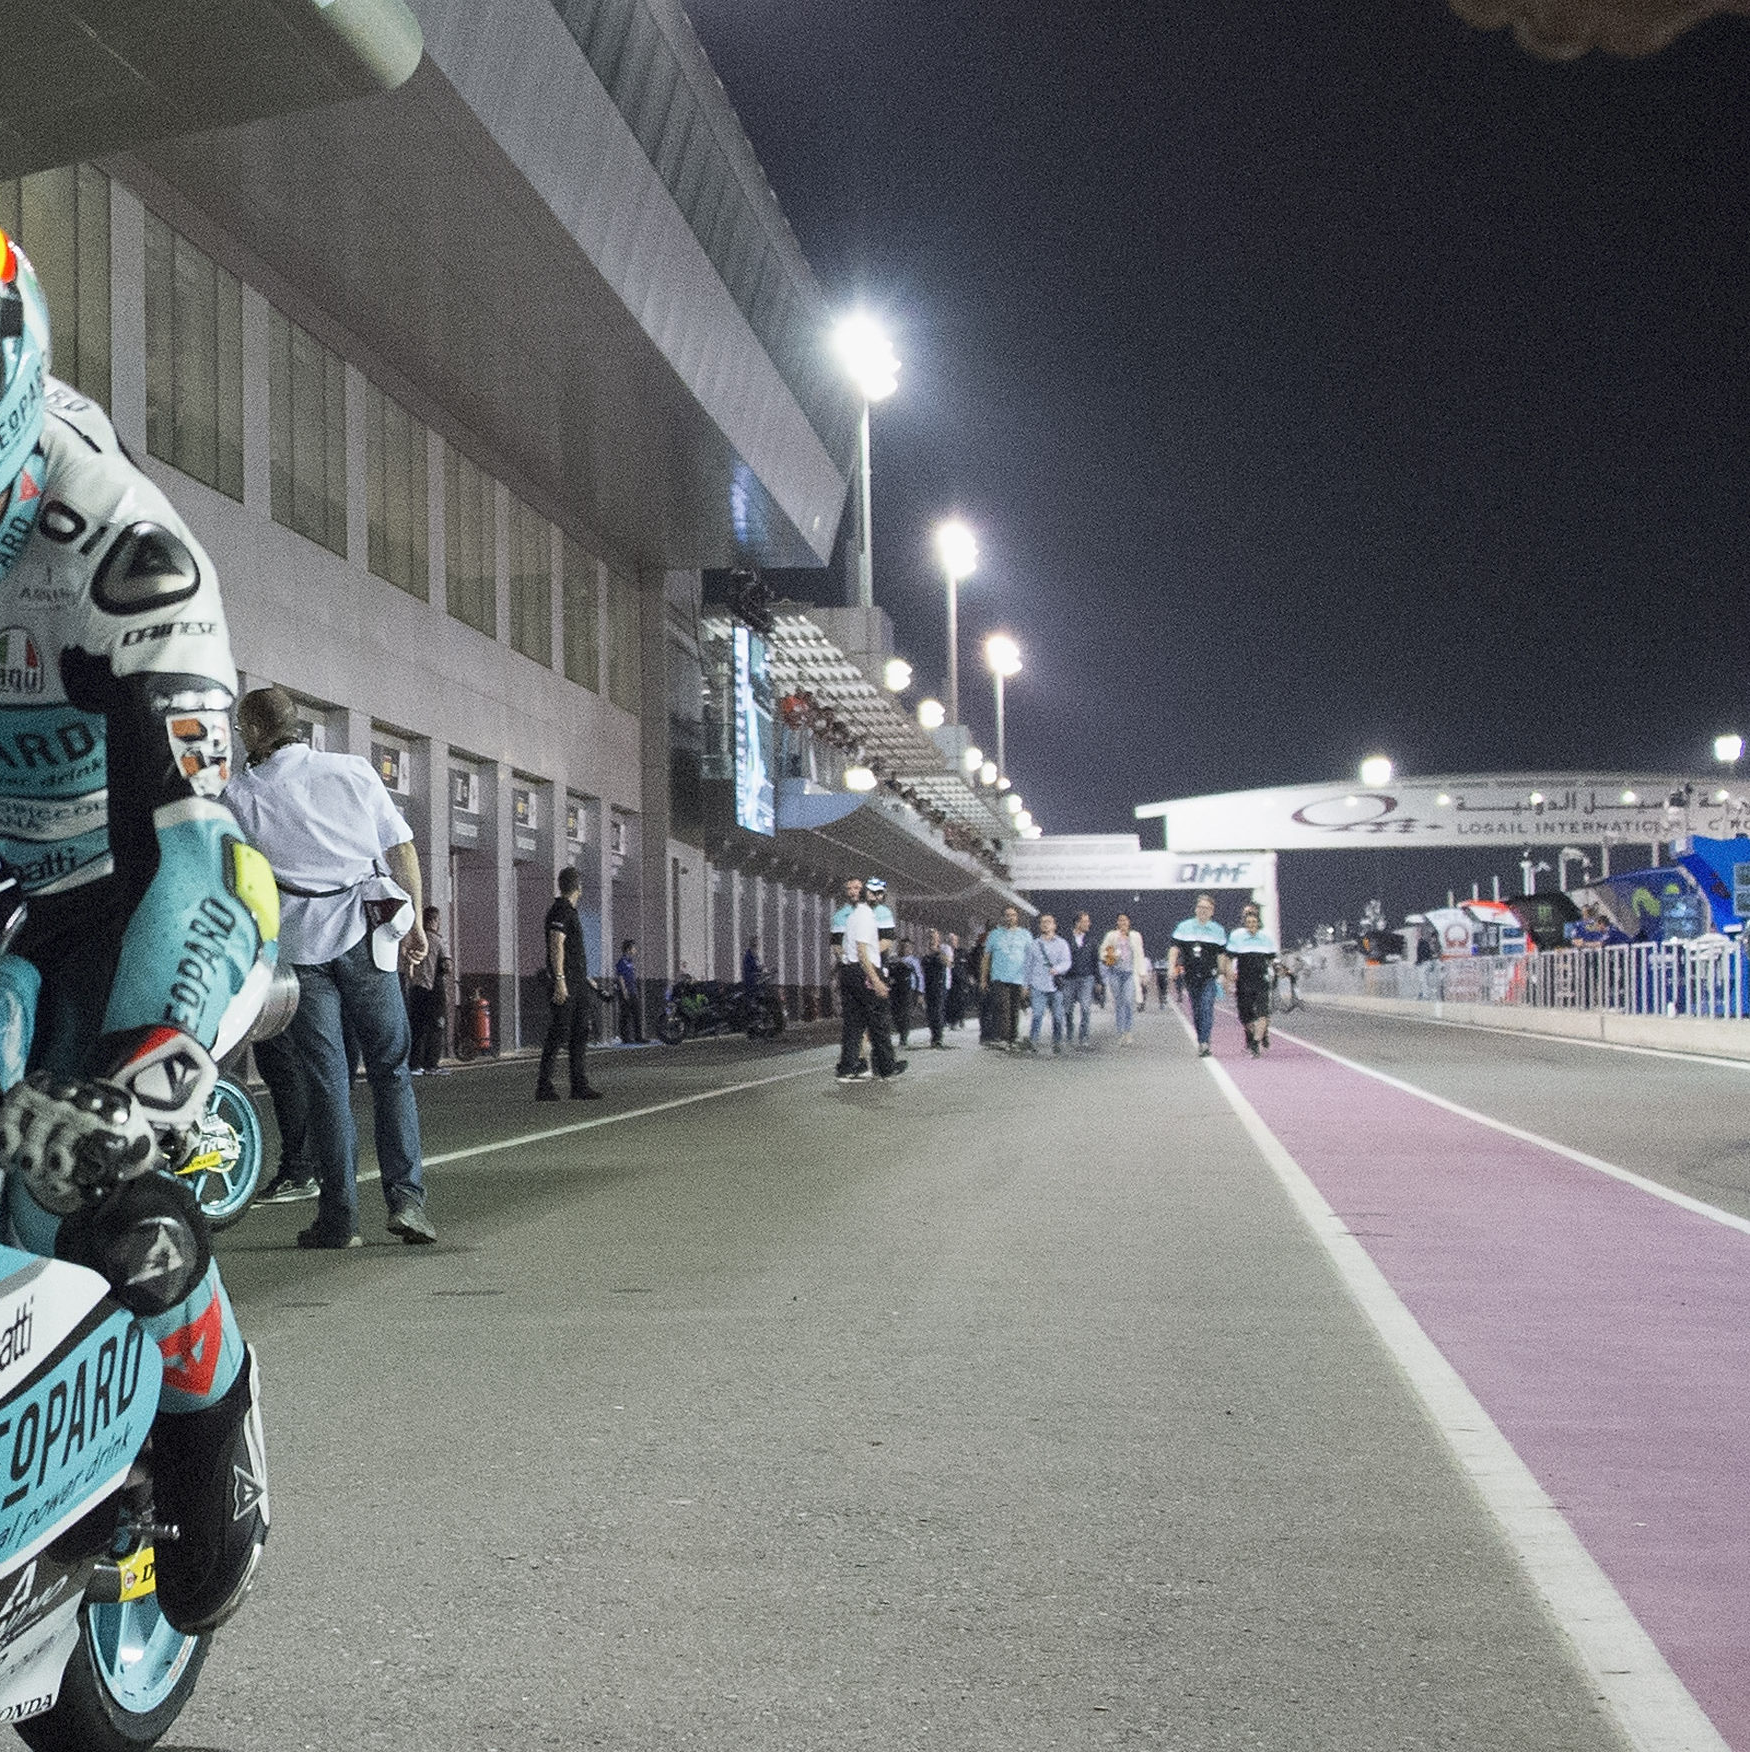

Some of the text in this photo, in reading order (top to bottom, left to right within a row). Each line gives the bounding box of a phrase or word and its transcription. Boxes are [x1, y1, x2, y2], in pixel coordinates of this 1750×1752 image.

[1457, 822, 1529, 835] LOSAIL
[162, 897, 236, 1034] EOPARD
[18, 1470, 86, 1548] power
[84, 1421, 134, 1484] drink
